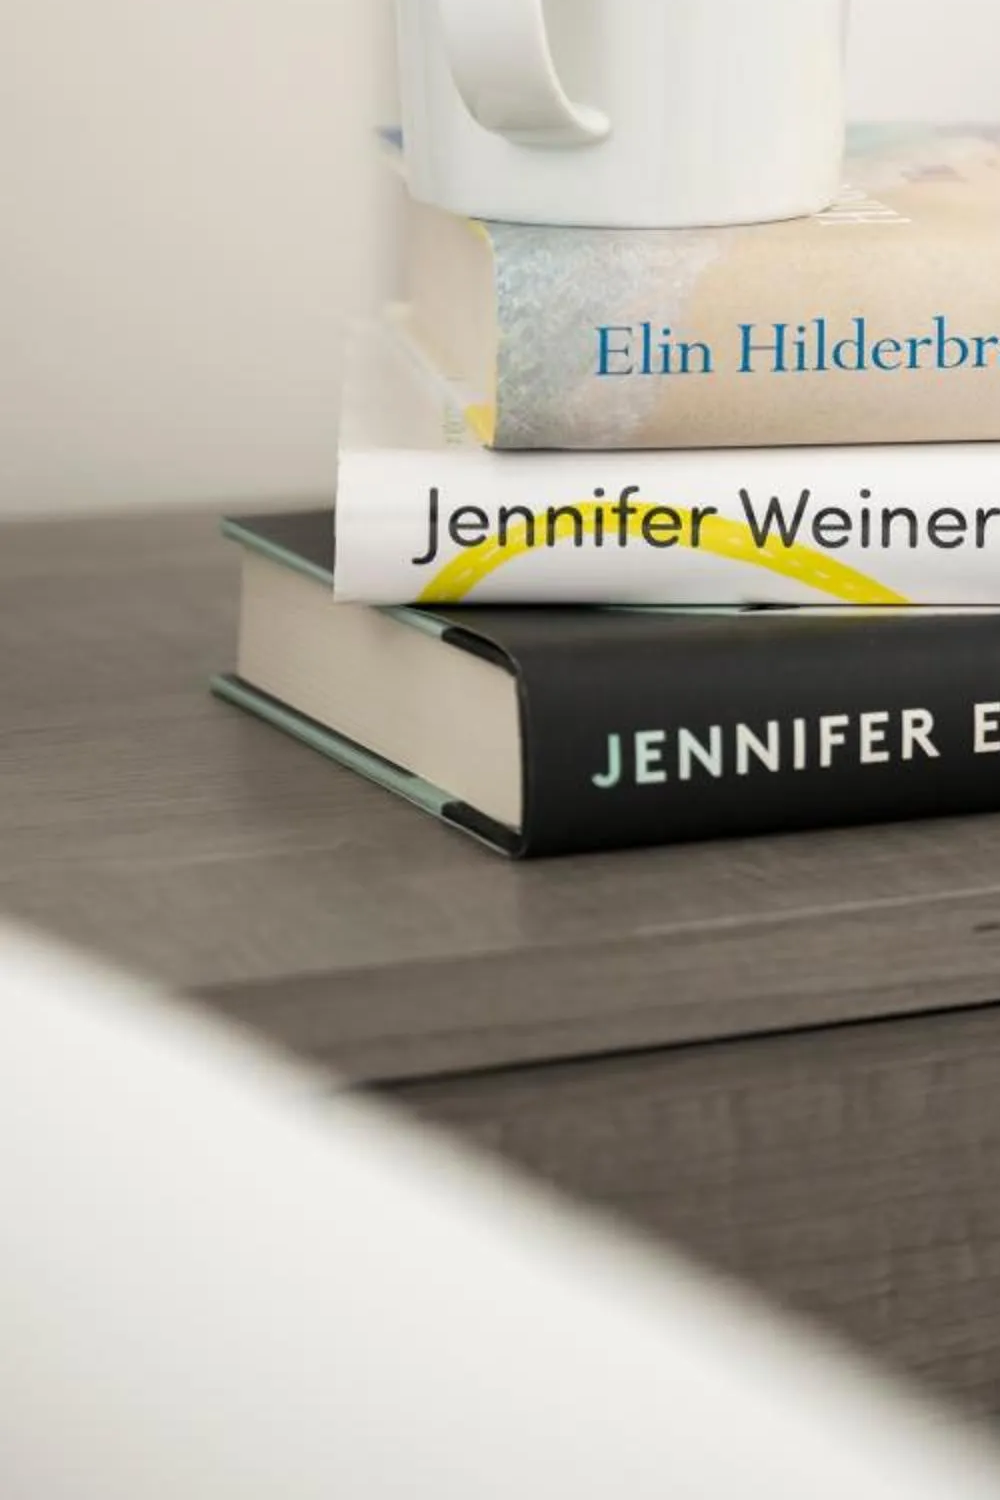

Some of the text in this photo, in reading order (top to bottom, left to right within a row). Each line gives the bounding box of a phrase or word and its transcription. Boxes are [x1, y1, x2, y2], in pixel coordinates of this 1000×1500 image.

[595, 321, 713, 376] Elin
[412, 486, 717, 565] Jennifer
[592, 708, 940, 788] JENNIFER
